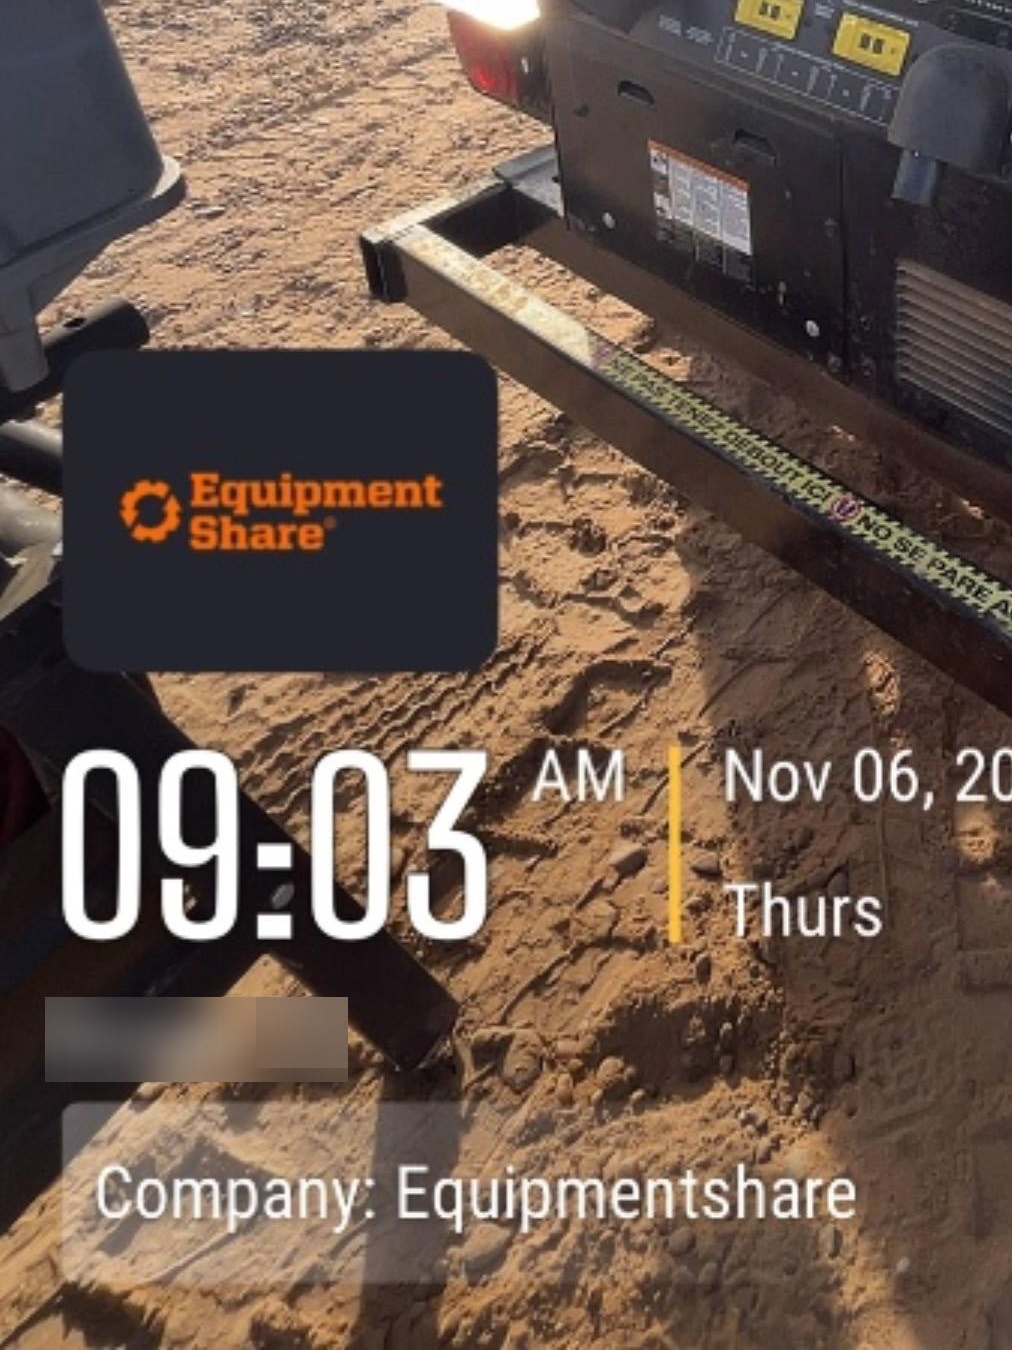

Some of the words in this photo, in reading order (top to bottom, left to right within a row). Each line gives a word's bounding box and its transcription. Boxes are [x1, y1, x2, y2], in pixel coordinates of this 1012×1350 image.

[857, 514, 892, 541] NO
[893, 537, 926, 562] SE
[926, 556, 993, 602] PARE
